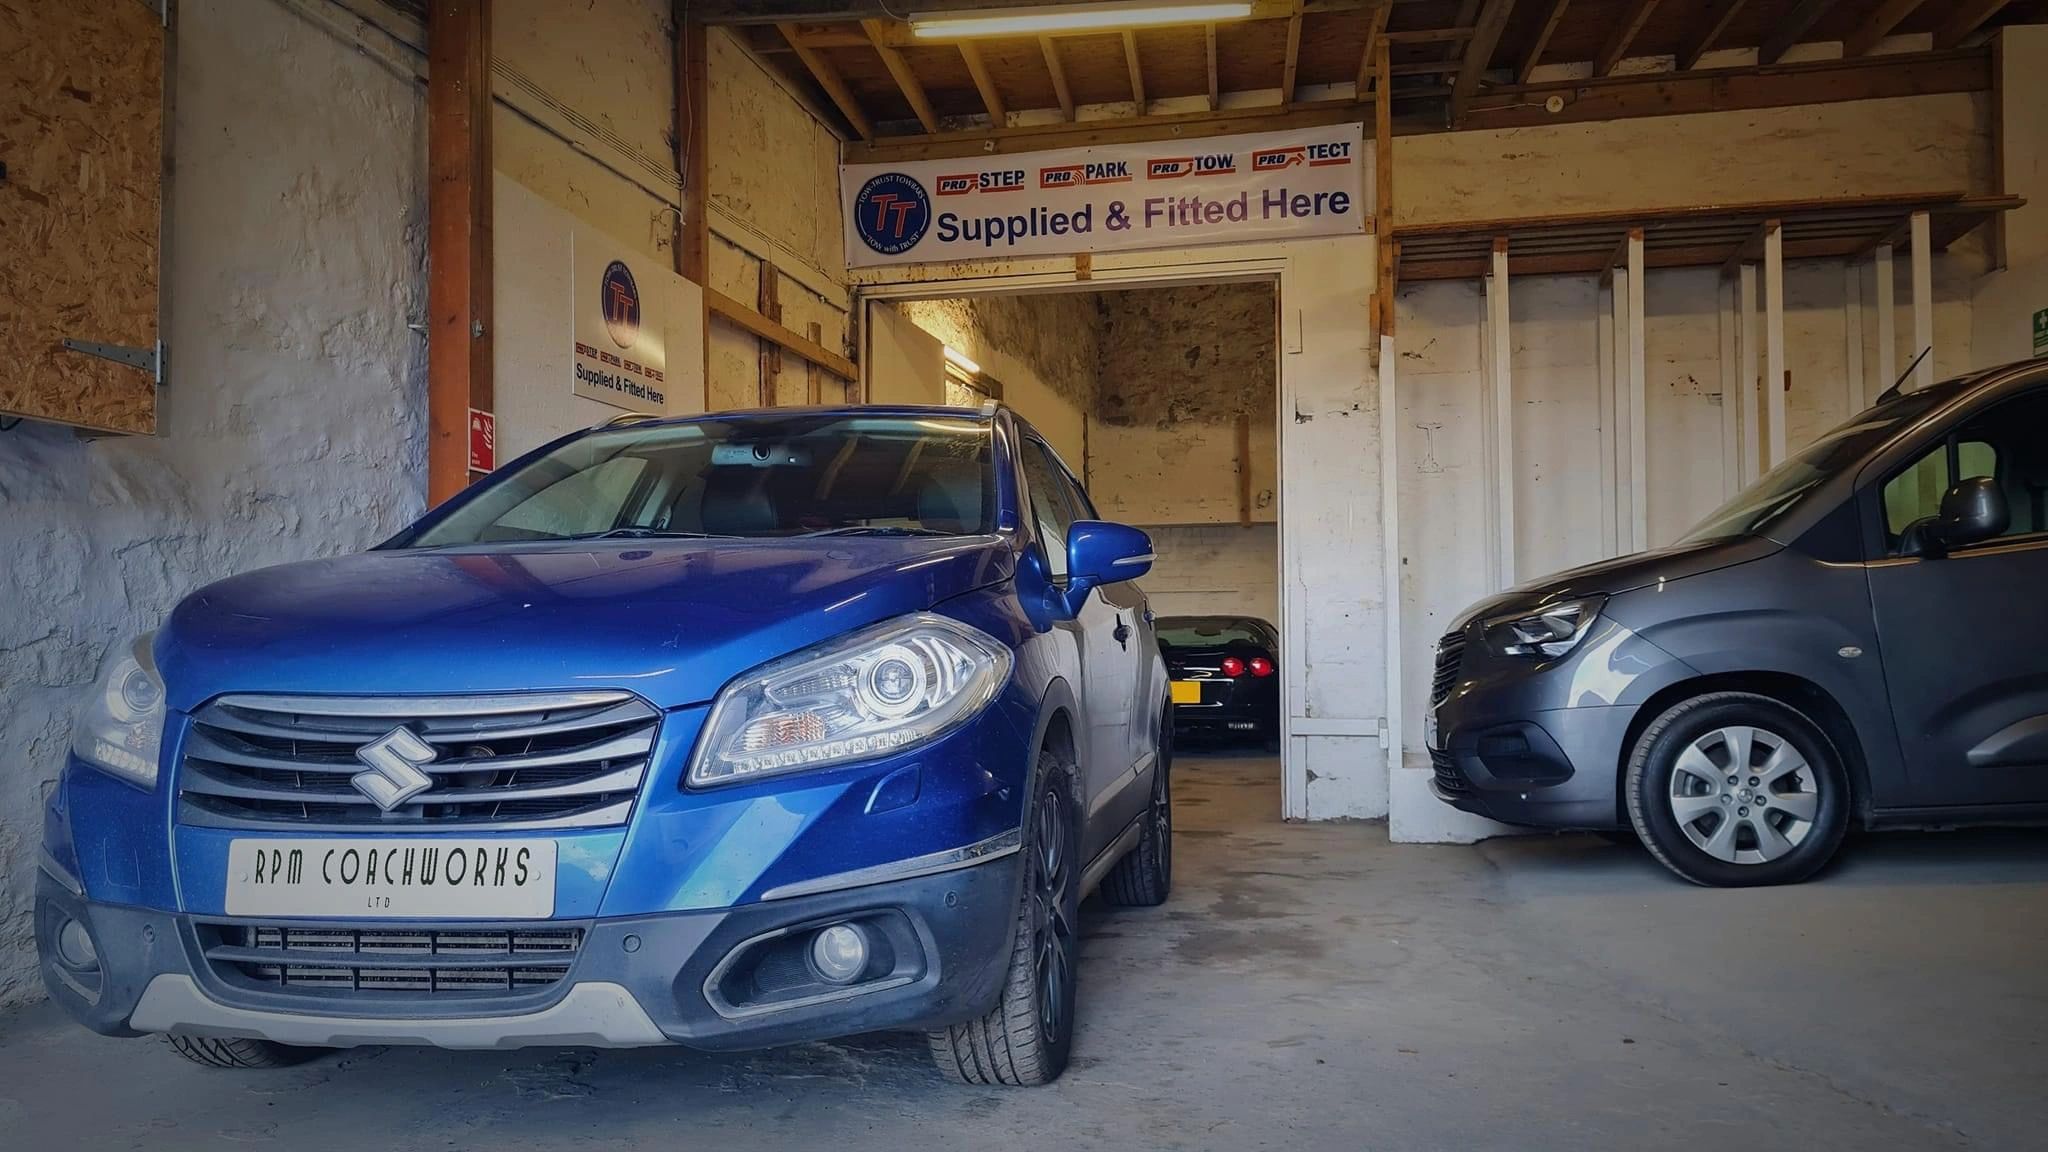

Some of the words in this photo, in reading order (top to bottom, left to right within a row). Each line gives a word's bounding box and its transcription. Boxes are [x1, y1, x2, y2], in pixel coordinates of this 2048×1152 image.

[1152, 163, 1179, 174] PRO
[1194, 153, 1234, 170] TOW
[1258, 154, 1286, 165] PRO
[1307, 142, 1351, 159] TECT
[942, 180, 967, 191] PRO
[979, 170, 1025, 187] STEP
[1045, 172, 1071, 182] PRO
[1086, 161, 1128, 179] PARK
[871, 193, 917, 238] TT
[937, 203, 1092, 247] Supplied
[1105, 200, 1132, 231] &
[1144, 191, 1248, 228] Fitted
[1262, 188, 1351, 220] Here
[576, 362, 614, 388] Supplied
[615, 375, 622, 391] &
[624, 378, 646, 399] Fitted
[647, 386, 664, 404] Here
[255, 848, 303, 885] RPM
[322, 847, 531, 887] COACHWORKS
